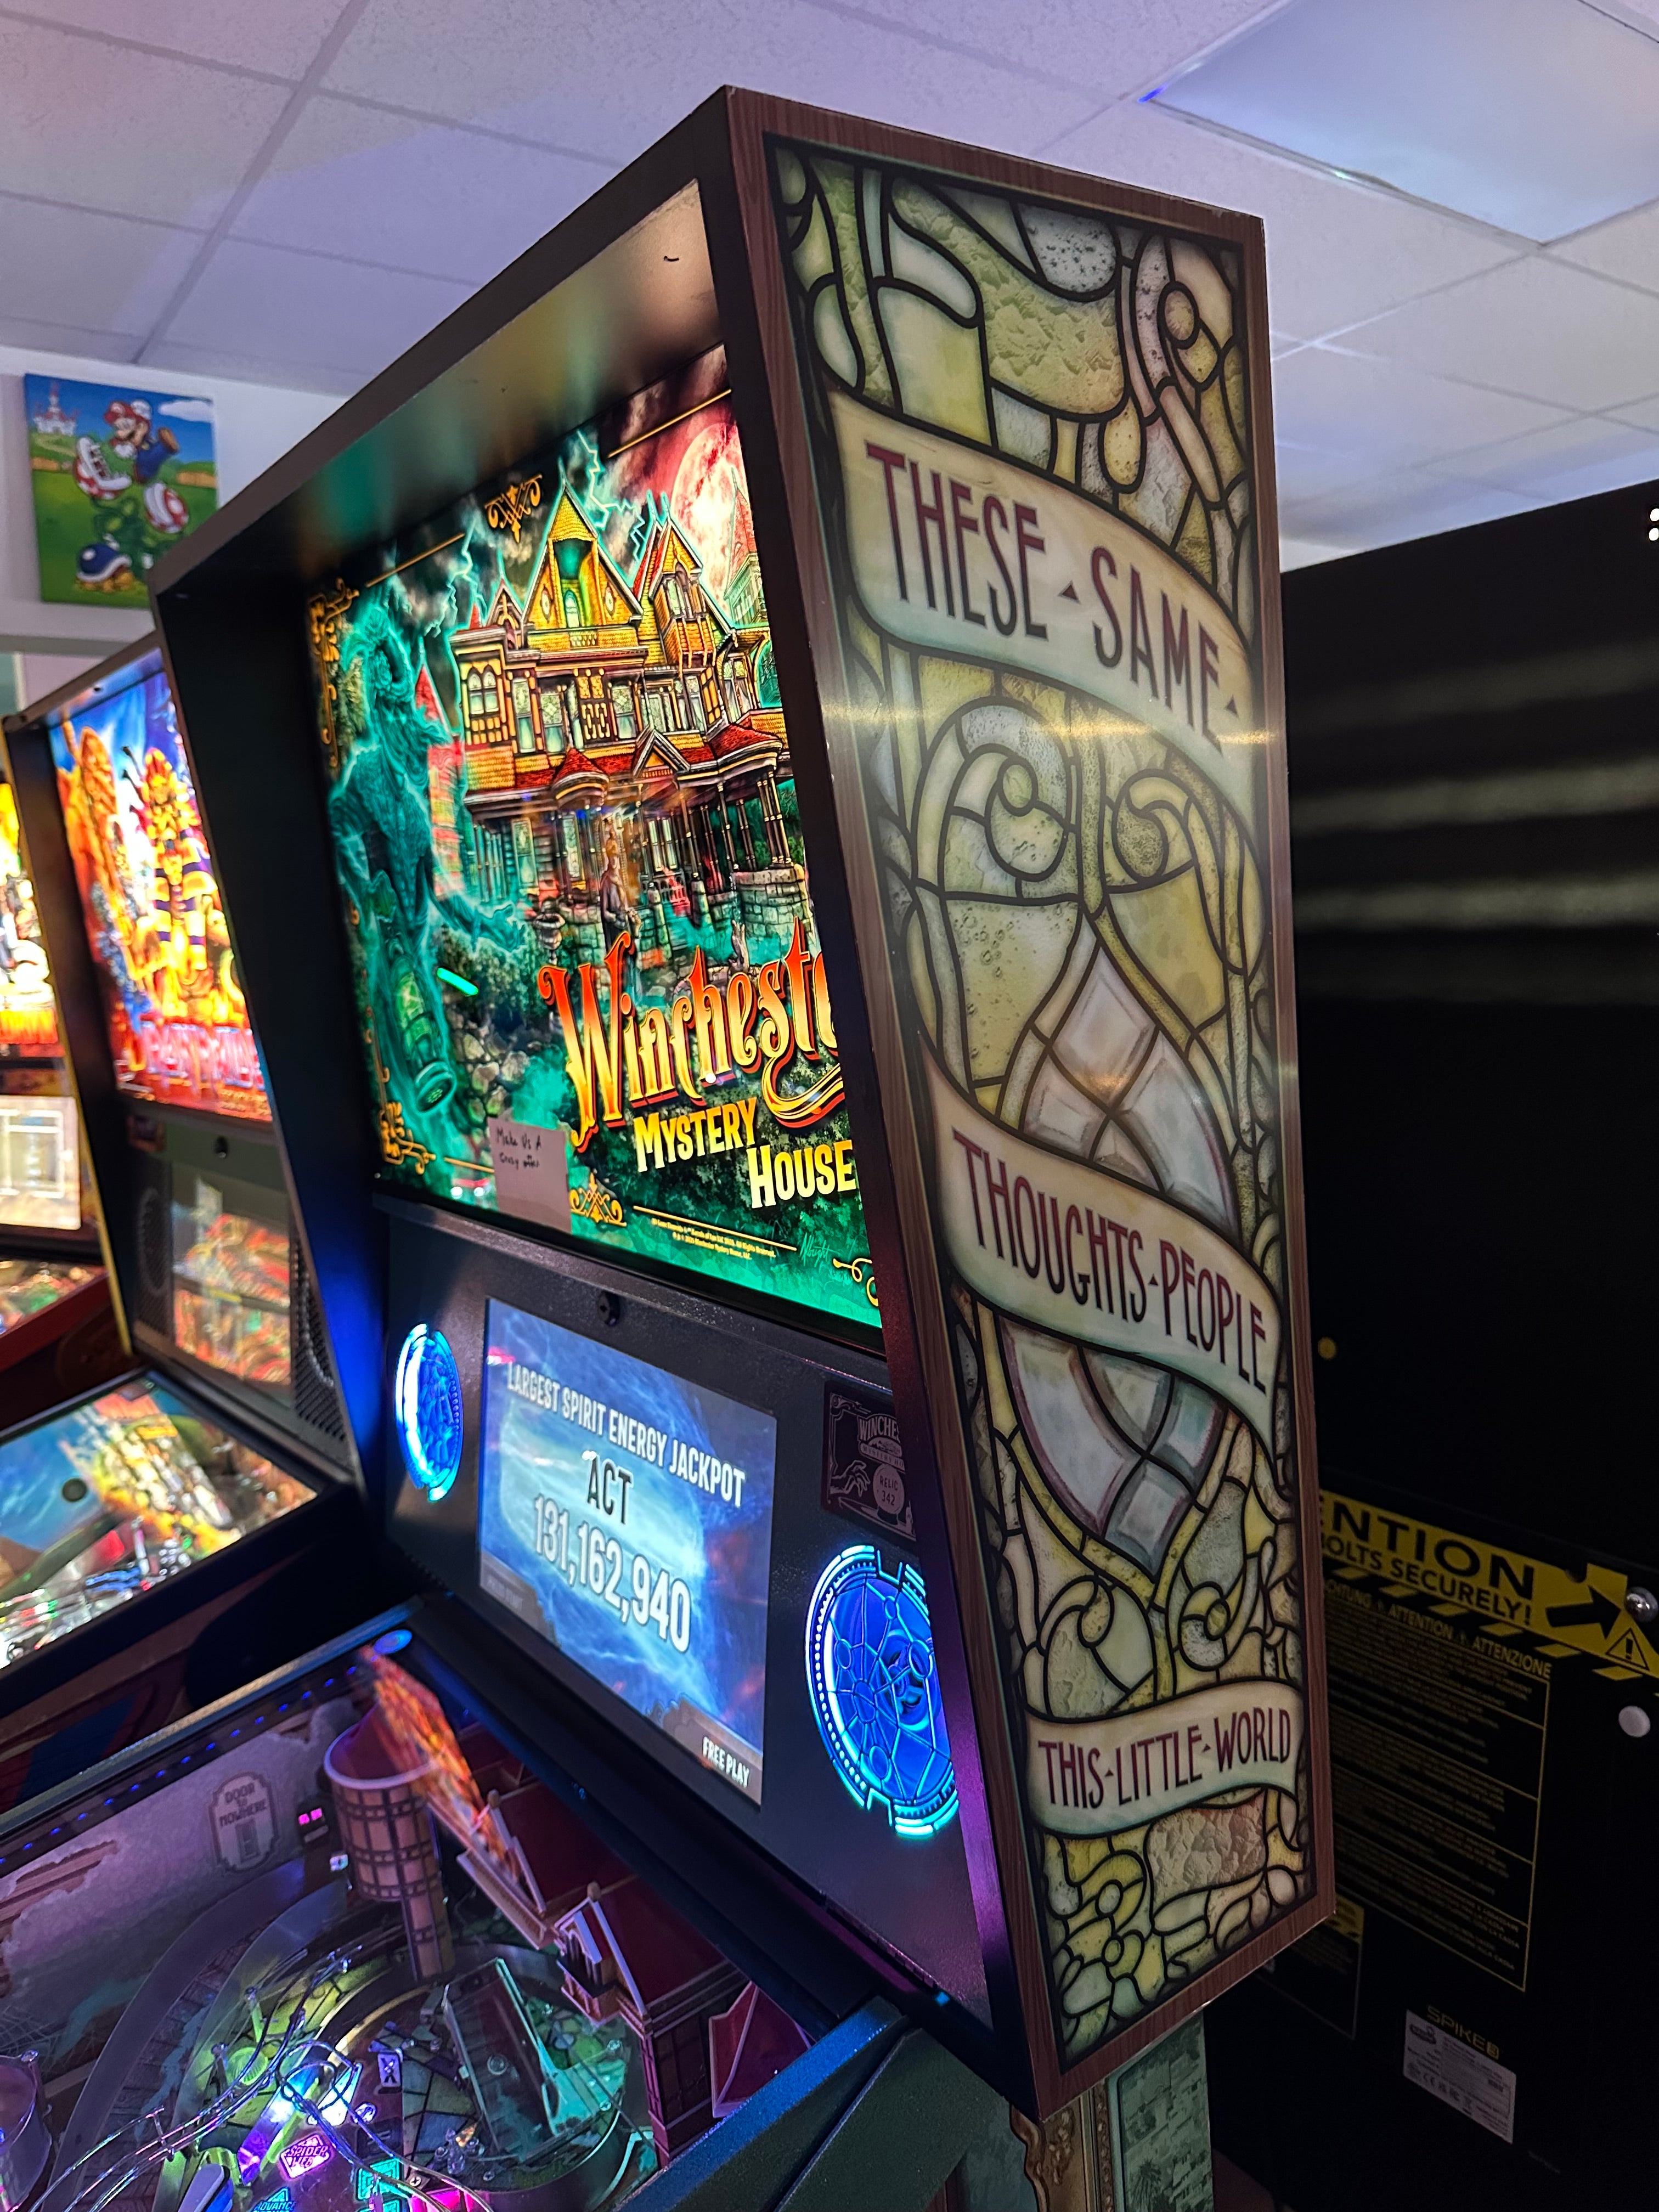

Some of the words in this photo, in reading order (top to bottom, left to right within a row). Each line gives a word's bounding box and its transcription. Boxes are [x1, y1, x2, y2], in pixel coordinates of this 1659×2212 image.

[866, 441, 1049, 642] THESE
[1091, 546, 1223, 759] SAME
[633, 1097, 758, 1173] MYSTERY
[747, 1139, 856, 1209] HOUSE
[952, 1126, 1147, 1323] THOUGHTS
[1159, 1238, 1267, 1395] PEOPLE
[507, 1361, 561, 1413] LARGEST
[562, 1386, 607, 1436] SPIRIT
[608, 1407, 668, 1468] ENERGY
[669, 1438, 746, 1509] JACKPOT
[859, 1415, 900, 1442] WINCHE
[586, 1454, 634, 1525] ACT
[879, 1475, 898, 1491] RELIC
[882, 1490, 895, 1506] 342
[534, 1493, 691, 1654] 131,162,940
[1319, 1497, 1534, 1601] NTION
[1390, 1559, 1531, 1626] SECURELY!
[225, 1782, 255, 1803] DOOR
[702, 1736, 725, 1771] FREE
[725, 1753, 750, 1788] PLAY
[1038, 1740, 1104, 1809] THIS
[1115, 1724, 1203, 1805] LITTLE
[1214, 1707, 1291, 1773] WORLD
[289, 2145, 329, 2157] SPIDER
[292, 2156, 315, 2168] WEB
